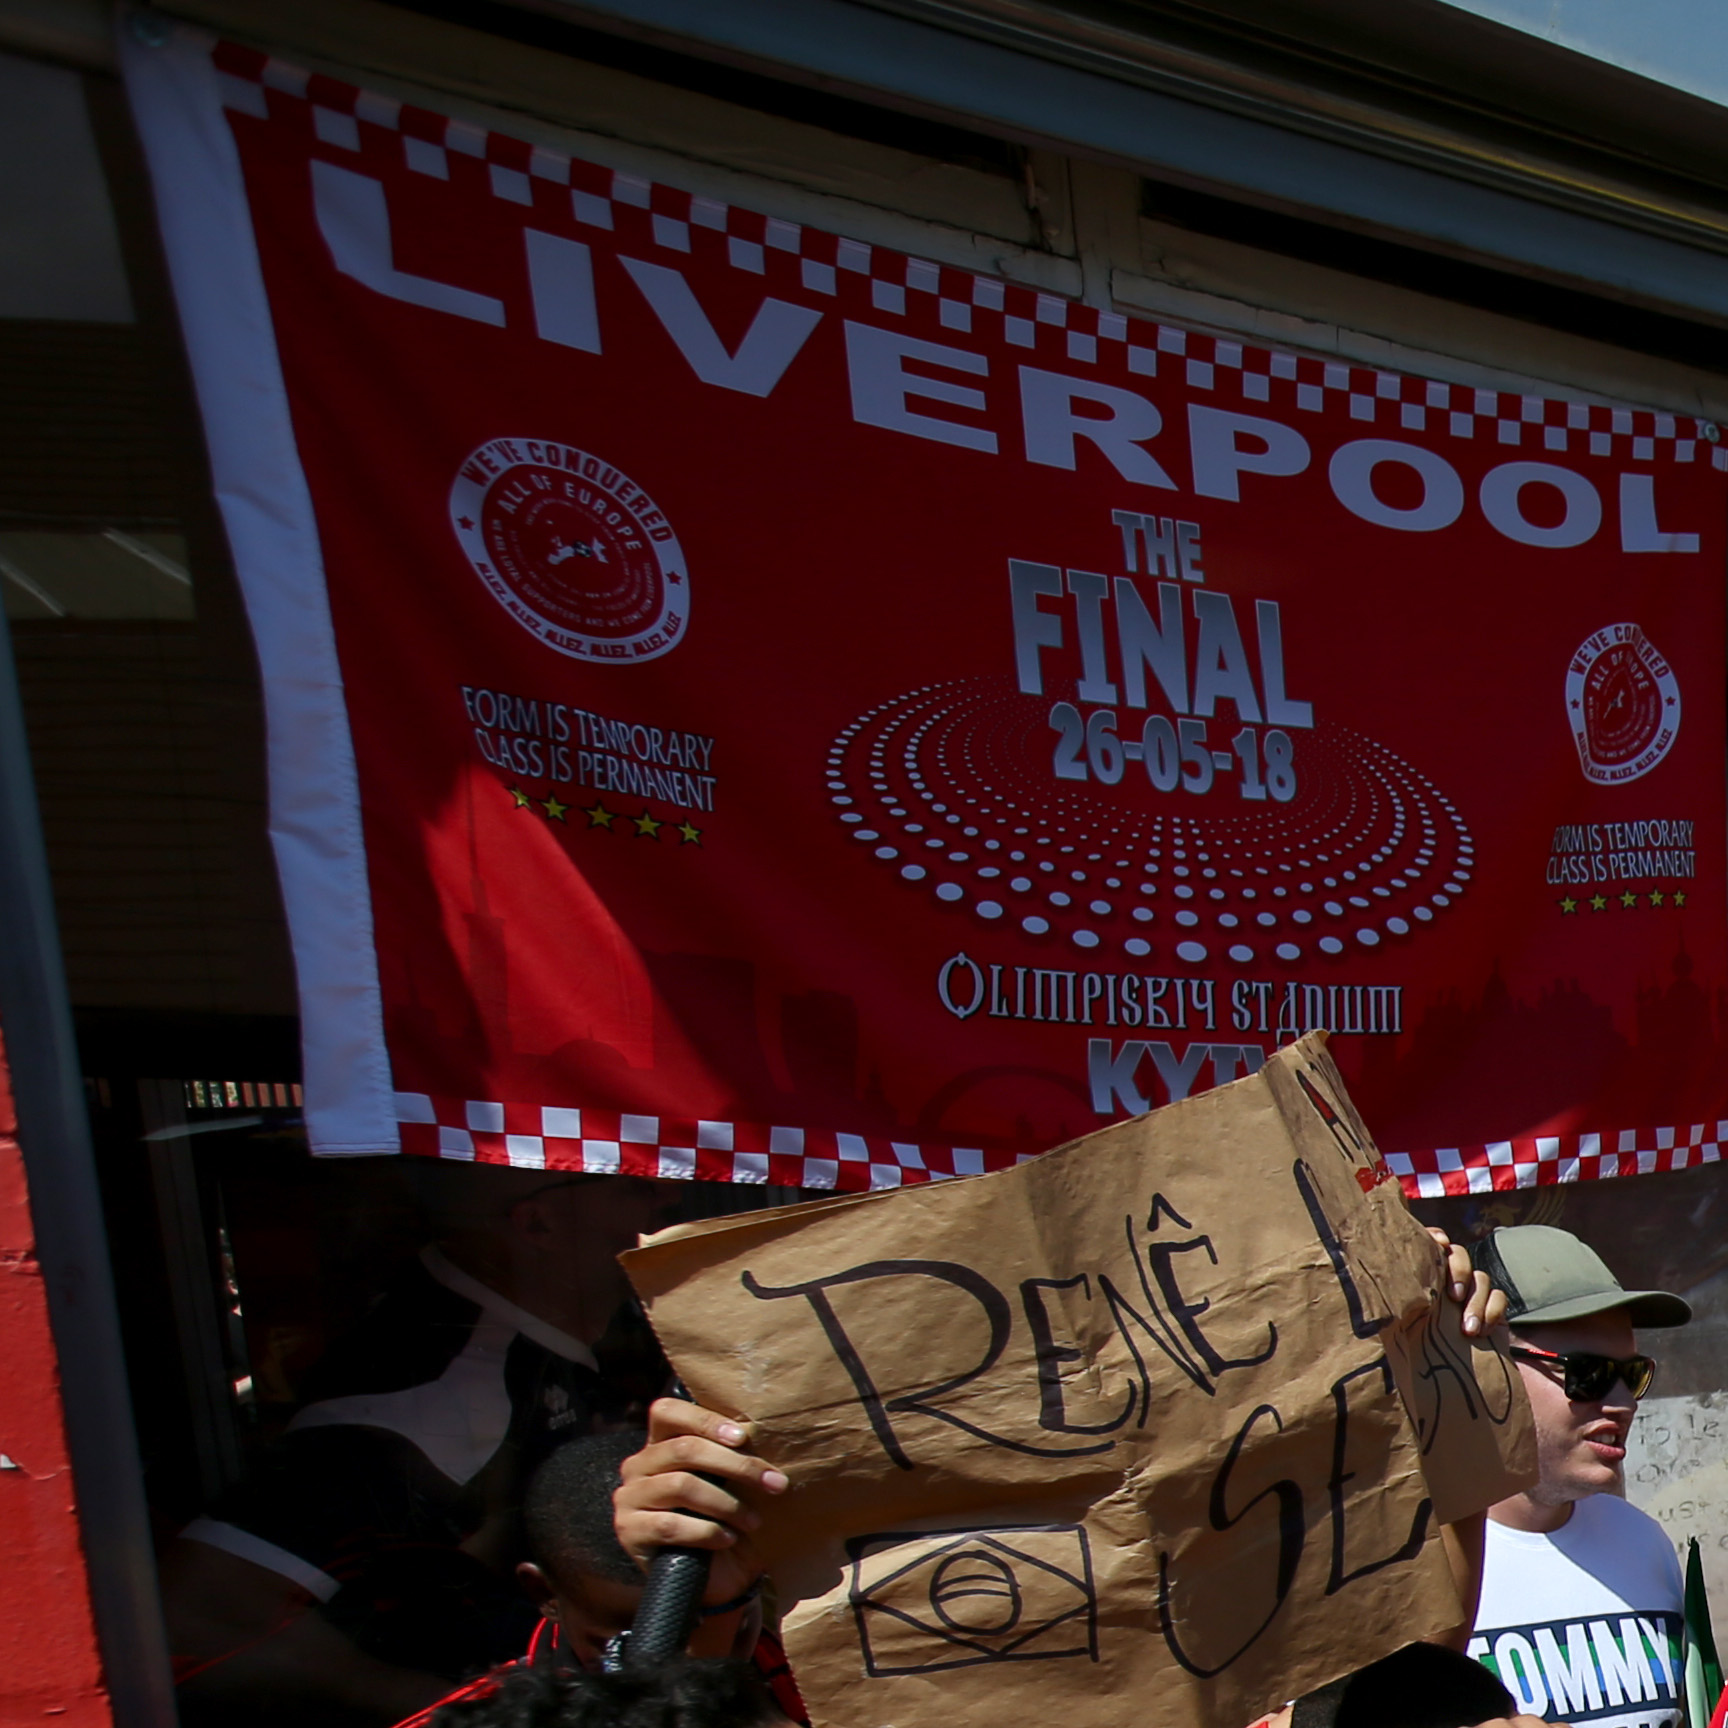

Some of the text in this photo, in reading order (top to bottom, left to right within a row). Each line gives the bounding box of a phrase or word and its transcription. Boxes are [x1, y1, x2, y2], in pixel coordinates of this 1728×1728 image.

[310, 158, 1700, 553] LIVERPOOL
[460, 440, 674, 543] WE'VE CONQUERED
[496, 480, 533, 515] ALL
[563, 481, 643, 551] EUROPE
[1111, 508, 1205, 583] THE
[1008, 557, 1314, 729] FINAL
[1570, 631, 1609, 675] WE'VE
[460, 685, 715, 772] FORM IS TEMPORARY
[1048, 701, 1297, 802] 26-05-18
[473, 726, 717, 813] CLASS IS PERMANENT
[1545, 850, 1696, 885] CLASS IS PERMANENT
[1550, 818, 1694, 853] FORM IS TEMPORARY
[1231, 978, 1402, 1043] STADIUM
[1087, 1038, 1275, 1116] KYI
